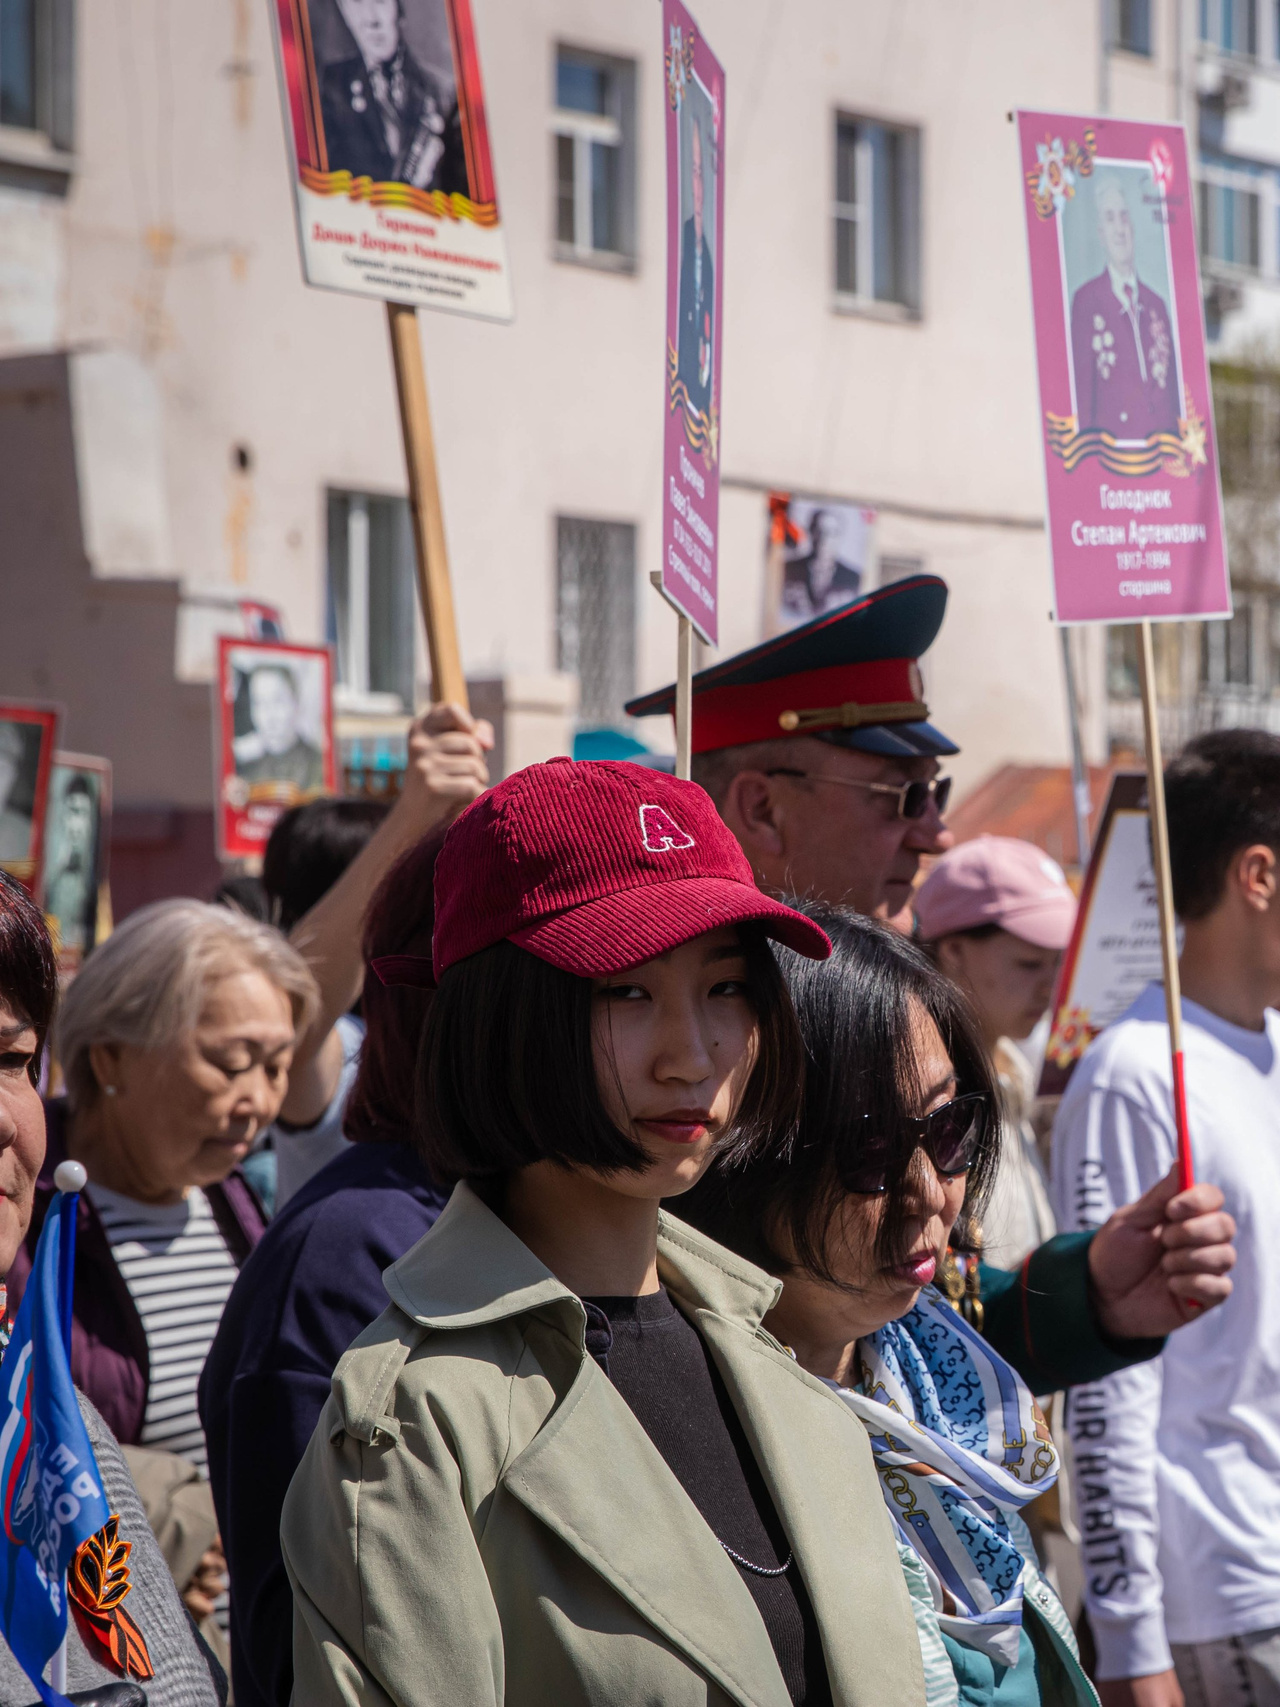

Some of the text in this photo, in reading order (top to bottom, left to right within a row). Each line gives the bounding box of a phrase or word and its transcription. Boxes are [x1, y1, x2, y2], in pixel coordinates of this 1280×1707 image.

[1100, 484, 1172, 513] Голоднюк
[1071, 519, 1206, 550] Степан Артемович
[1119, 579, 1172, 600] старшина
[639, 804, 694, 852] A
[1076, 1454, 1130, 1597] HABITS
